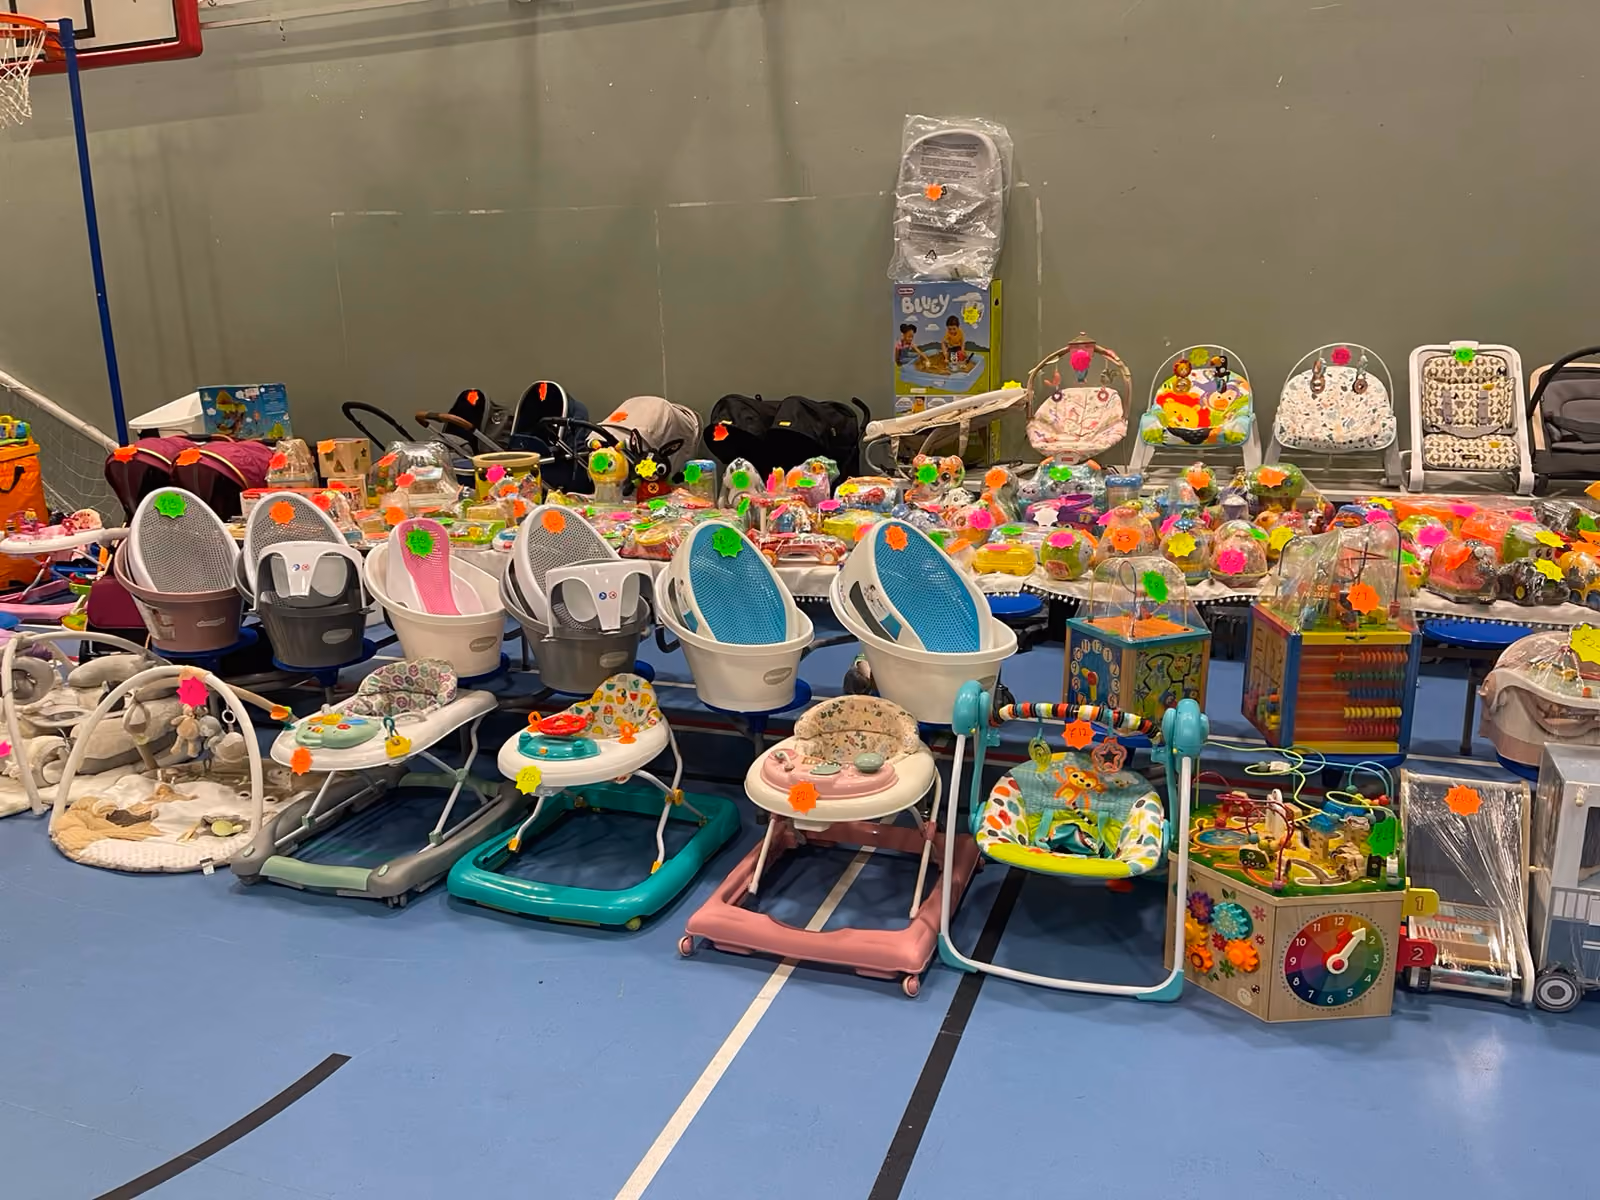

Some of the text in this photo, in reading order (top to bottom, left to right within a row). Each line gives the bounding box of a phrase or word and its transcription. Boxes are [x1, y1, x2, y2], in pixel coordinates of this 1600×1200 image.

[901, 294, 950, 318] BLUEY
[1414, 895, 1425, 912] 1
[1334, 916, 1345, 926] 12
[1313, 923, 1321, 932] 11
[1295, 938, 1307, 947] 10
[1368, 935, 1376, 945] 2
[1372, 954, 1380, 963] 3
[1411, 947, 1424, 961] 2
[1289, 956, 1297, 966] 9
[1292, 977, 1300, 986] 8
[1364, 974, 1372, 982] 4
[1308, 989, 1315, 999] 7
[1346, 988, 1354, 997] 5
[1326, 995, 1334, 1004] 6
